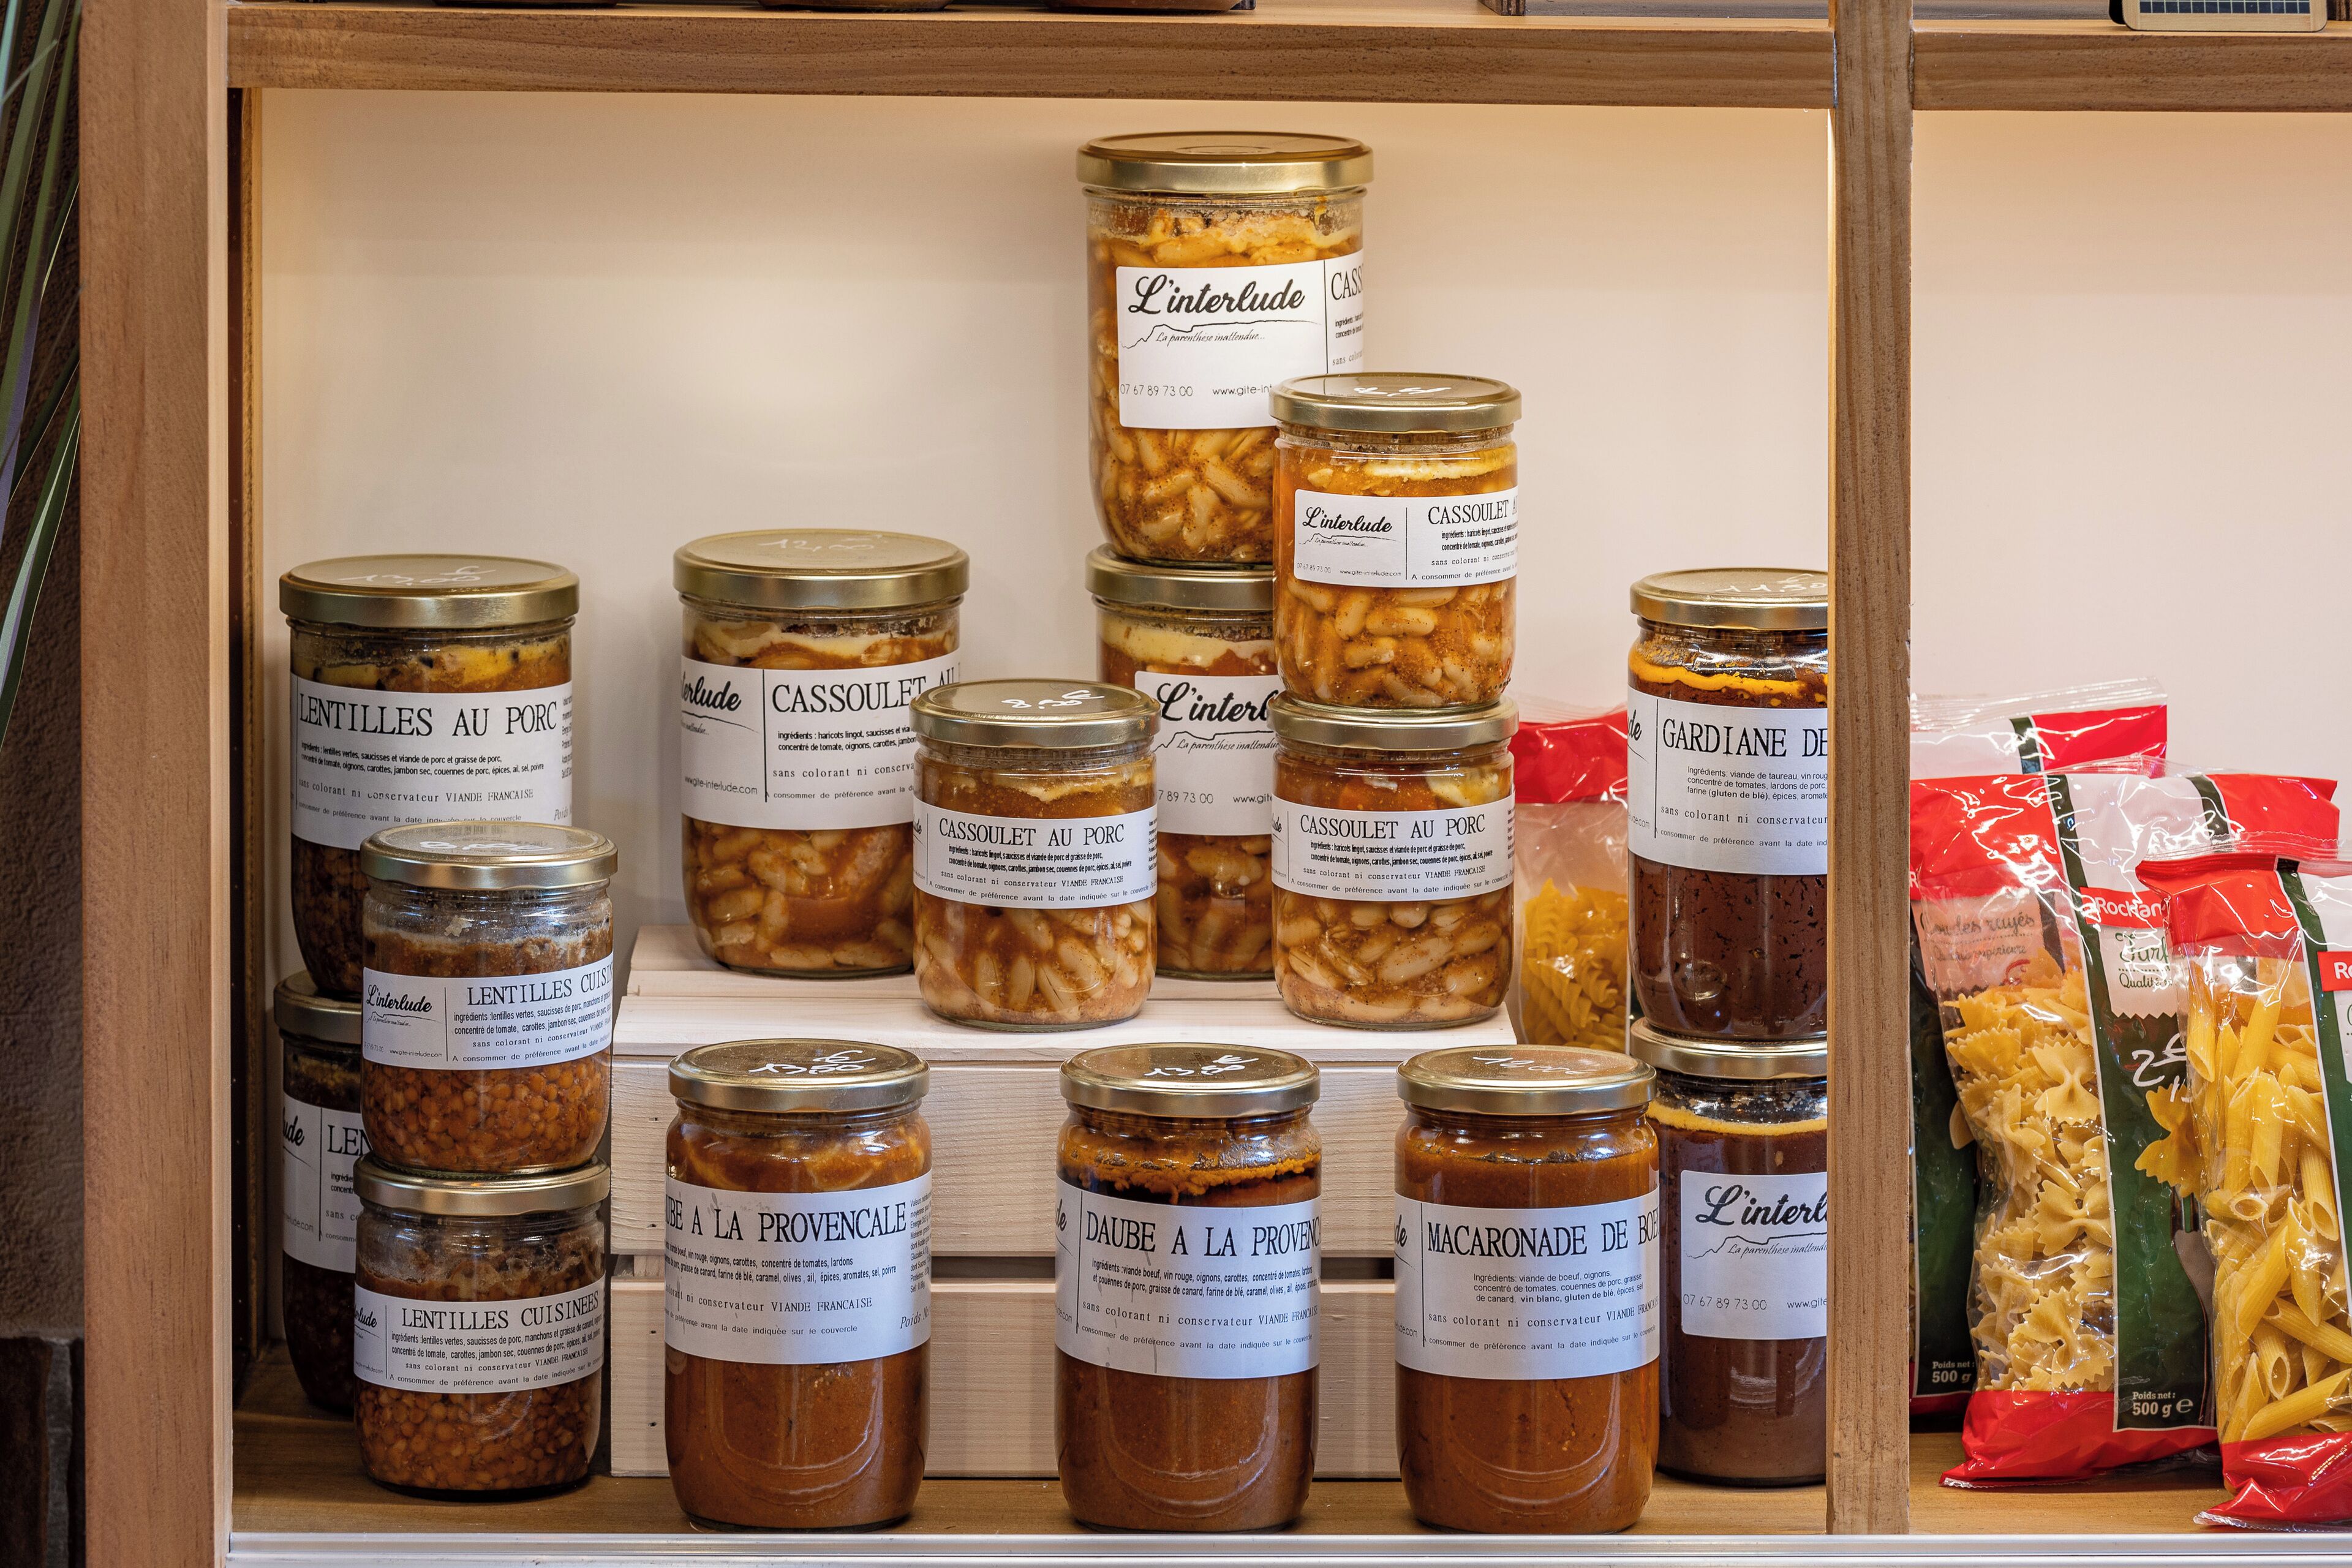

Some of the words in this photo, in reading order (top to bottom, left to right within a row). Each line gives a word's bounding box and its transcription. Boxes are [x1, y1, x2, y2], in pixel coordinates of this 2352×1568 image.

[1331, 267, 1363, 300] CASS
[1128, 274, 1305, 315] L'interlude
[1156, 332, 1167, 342] La
[1120, 383, 1130, 394] 07
[1133, 385, 1144, 394] 67
[1147, 385, 1159, 396] 89
[1163, 385, 1176, 397] 73
[1179, 386, 1193, 397] 00
[1212, 385, 1272, 396] www.gite-in
[1302, 507, 1393, 533] L'interlude
[1428, 499, 1509, 524] CASSOULET
[772, 675, 927, 713] CASSOULET
[1156, 682, 1280, 722] L'interl
[299, 693, 432, 736] LENTILLES
[452, 708, 490, 736] AU
[505, 701, 557, 735] PORC
[1177, 739, 1189, 749] La
[1236, 737, 1279, 751] inattendu
[1662, 718, 1787, 757] GARDIANE
[802, 766, 849, 778] colorant
[858, 766, 867, 775] ni
[1688, 766, 1728, 778] Ingrédients:
[1730, 771, 1755, 779] viande
[1769, 772, 1798, 780] taureau,
[1812, 772, 1828, 782] roug
[312, 782, 345, 796] colorant
[446, 792, 483, 802] VIANDE
[488, 789, 533, 801] FRANCAISE
[1687, 777, 1722, 786] concentré
[1736, 780, 1768, 790] tomates,
[1687, 786, 1706, 795] farine
[1709, 789, 1737, 799] (gluten
[1752, 791, 1770, 801] blé),
[1773, 792, 1798, 801] épices,
[1167, 791, 1178, 802] 89
[1183, 792, 1196, 803] 73
[1199, 793, 1214, 804] 00
[1661, 806, 1678, 816] sans
[1684, 809, 1730, 822] colorant
[1737, 813, 1748, 823] ni
[940, 818, 1036, 846] CASSOULET
[1047, 828, 1072, 846] AU
[1083, 824, 1125, 845] PORC
[1300, 815, 1399, 839] CASSOULET
[1410, 820, 1434, 839] AU
[1446, 813, 1485, 837] PORC
[957, 873, 986, 883] colorant
[1090, 876, 1123, 886] FRANCAISE
[1319, 870, 1350, 878] colorant
[1454, 865, 1486, 876] FRANCAISE
[2095, 897, 2162, 918] Rocklan
[366, 984, 432, 1013] L'interlude
[467, 978, 572, 1006] LENTILLES
[495, 1038, 530, 1046] colorant
[535, 1035, 543, 1044] ni
[548, 1028, 588, 1042] conservateur
[327, 1125, 374, 1156] LEN
[1695, 1184, 1827, 1226] L'interl
[666, 1194, 684, 1231] UBE
[691, 1205, 703, 1236] A
[714, 1208, 744, 1241] LA
[758, 1202, 907, 1243] PROVENCALE
[1085, 1210, 1156, 1253] DAUBE
[1171, 1225, 1188, 1256] A
[1204, 1226, 1237, 1257] LA
[1427, 1222, 1588, 1258] MACARONADE
[1601, 1219, 1628, 1253] DE
[1727, 1243, 1741, 1254] La
[1790, 1242, 1827, 1254] inattend
[402, 1308, 509, 1330] LENTILLES
[521, 1290, 600, 1327] CUISINEES
[686, 1292, 693, 1303] ni
[698, 1297, 764, 1311] conservateur
[771, 1301, 811, 1312] VIANDE
[817, 1297, 872, 1312] FRANCAISE
[1683, 1294, 1695, 1305] 07
[1700, 1296, 1712, 1307] 67
[1716, 1297, 1730, 1309] 89
[1735, 1298, 1748, 1310] 73
[1752, 1300, 1766, 1310] 00
[1787, 1298, 1827, 1308] www.gite
[1083, 1299, 1100, 1312] sans
[1105, 1304, 1150, 1322] colorant
[1159, 1313, 1169, 1324] ni
[1178, 1314, 1253, 1327] conservateur
[1258, 1313, 1289, 1325] VIANDE
[1428, 1313, 1447, 1323] sans
[1453, 1315, 1499, 1327] colorant
[1508, 1317, 1519, 1327] ni
[1528, 1313, 1601, 1327] conservateur
[1606, 1307, 1635, 1321] VIANDE
[478, 1362, 531, 1371] conservateur
[535, 1356, 559, 1366] VIANDE
[1932, 1371, 1958, 1383] 500
[1961, 1373, 1971, 1383] g
[2133, 1401, 2158, 1415] 500
[2162, 1404, 2172, 1417] g
